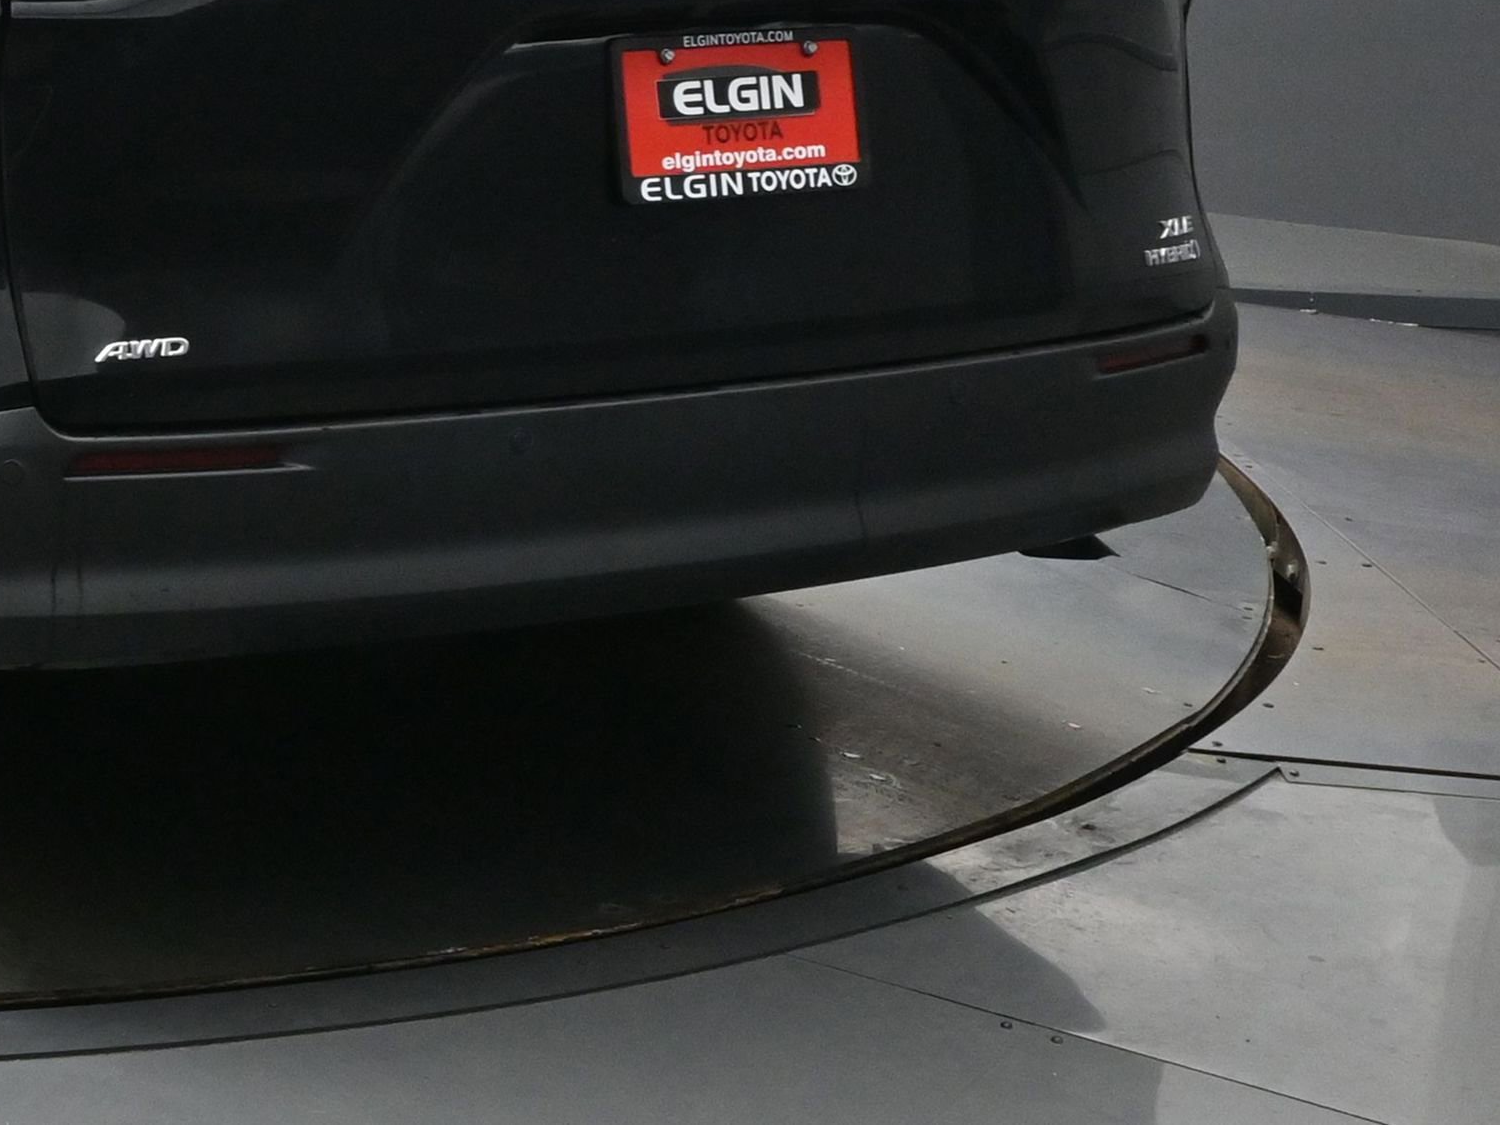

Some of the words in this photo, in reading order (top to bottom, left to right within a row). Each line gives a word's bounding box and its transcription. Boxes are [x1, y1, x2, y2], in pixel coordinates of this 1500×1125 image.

[682, 30, 794, 48] ELGINTOYOTA.COM
[672, 73, 805, 116] ELGIN
[701, 120, 784, 146] TOYOTA
[661, 143, 827, 174] elgintoyota.com
[640, 172, 744, 202] ELGIN
[746, 166, 833, 193] TOYOTA
[94, 336, 190, 363] AWD
